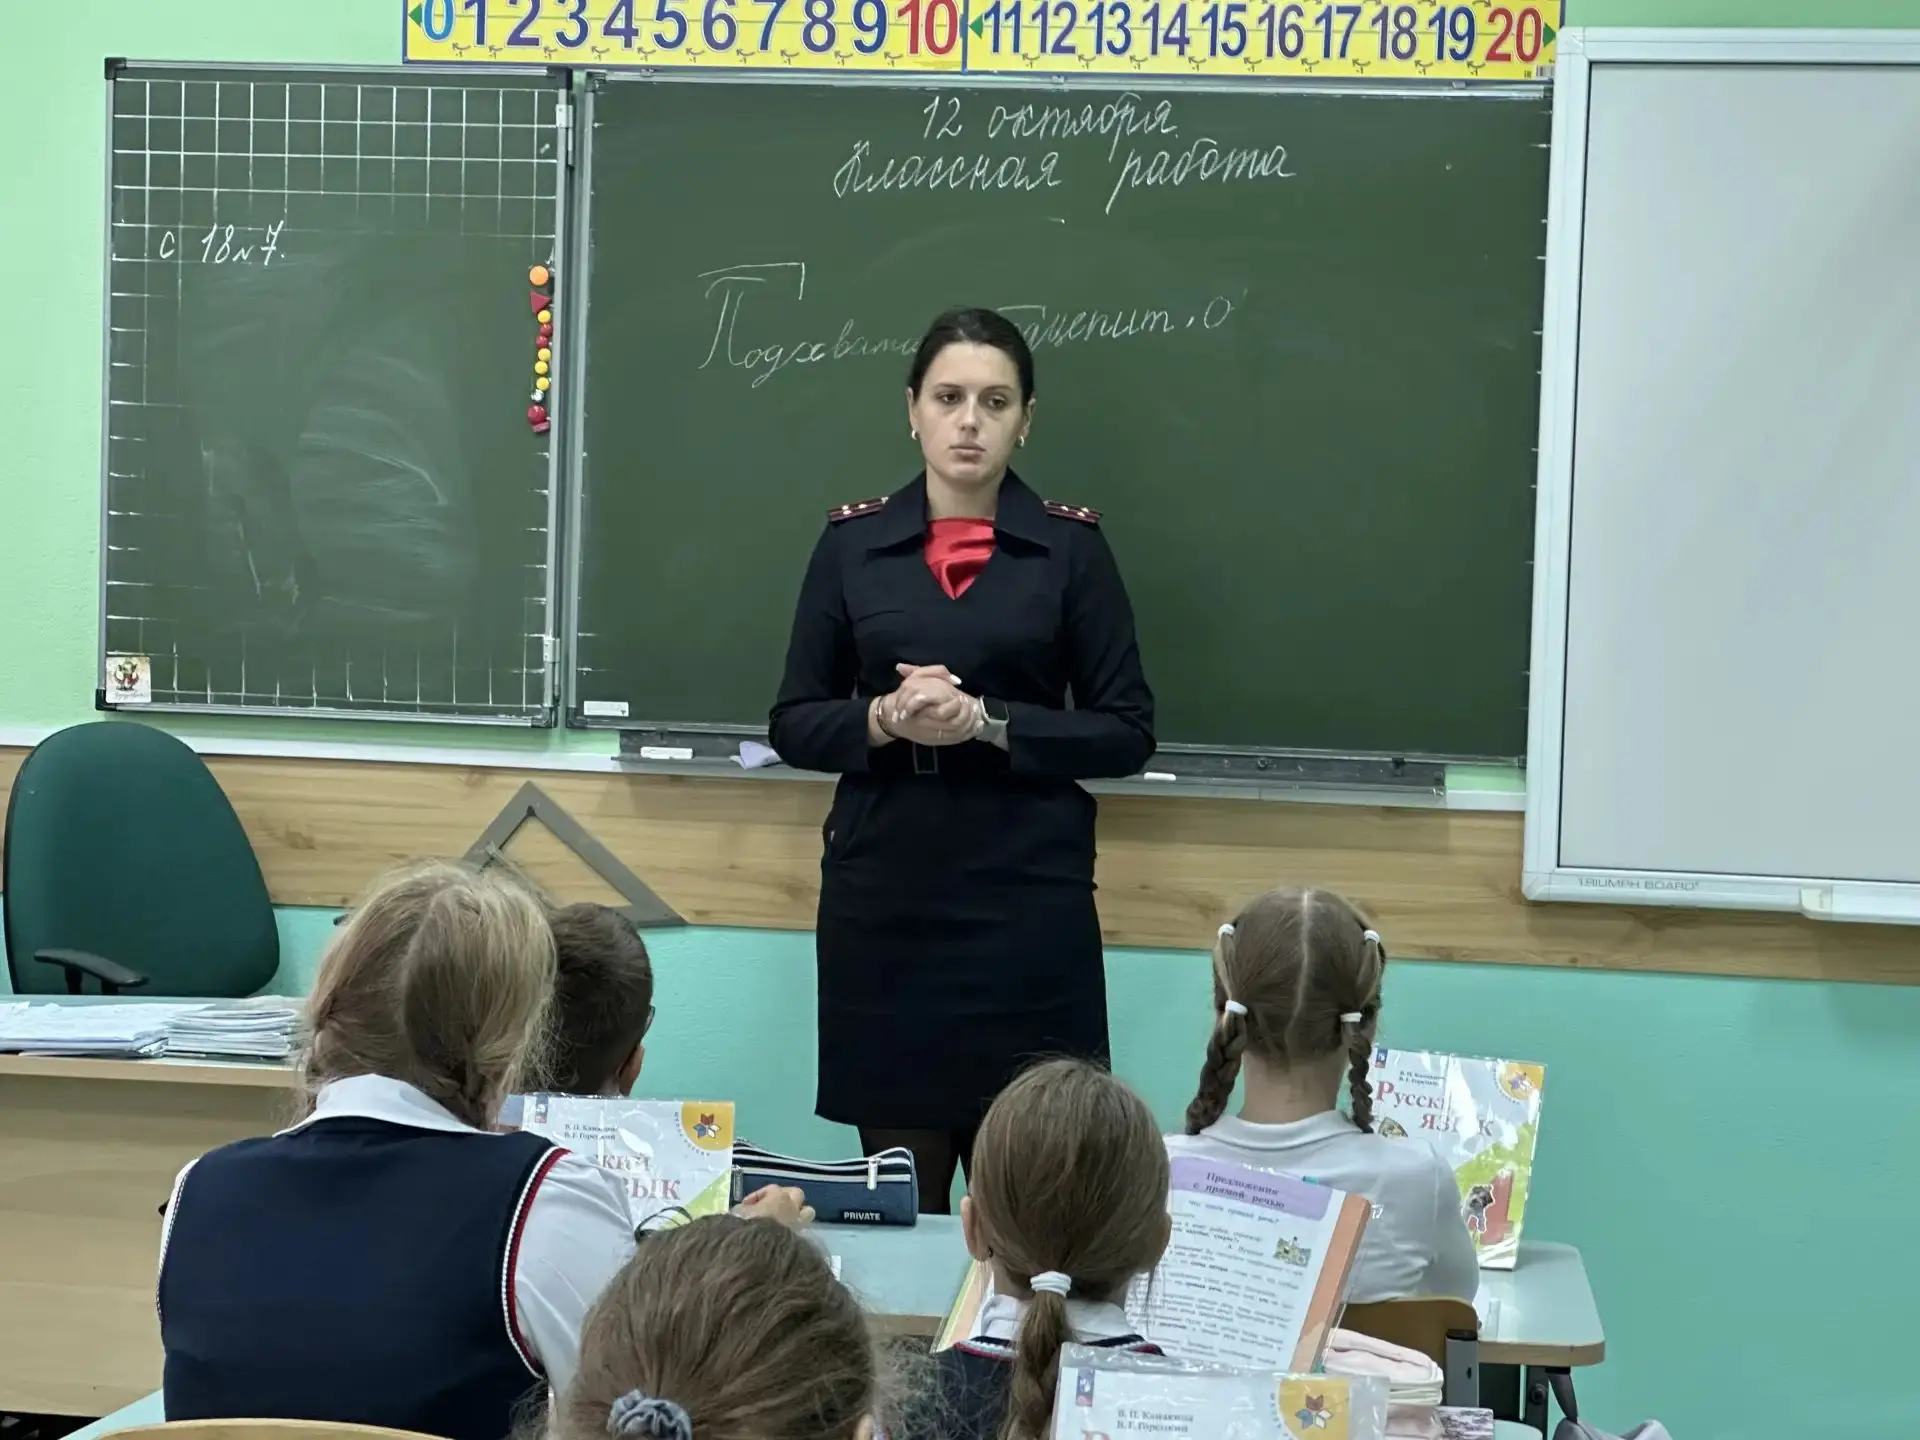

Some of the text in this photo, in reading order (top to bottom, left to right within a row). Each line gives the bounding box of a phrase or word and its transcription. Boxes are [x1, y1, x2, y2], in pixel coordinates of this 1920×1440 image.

[424, 0, 958, 54] 0 1 2 3 4 5 6 7 8 9 10
[984, 0, 1542, 62] 11 12 13 14 15 16 17 18 19 20
[923, 96, 963, 139] 12
[834, 138, 1297, 214] Классная работа
[1579, 877, 1640, 889] TRIUMPH
[1205, 1184, 1245, 1199] прямой
[1252, 1194, 1285, 1209] речью
[1206, 1172, 1280, 1196] Предложения
[843, 1211, 881, 1221] PRIVATE
